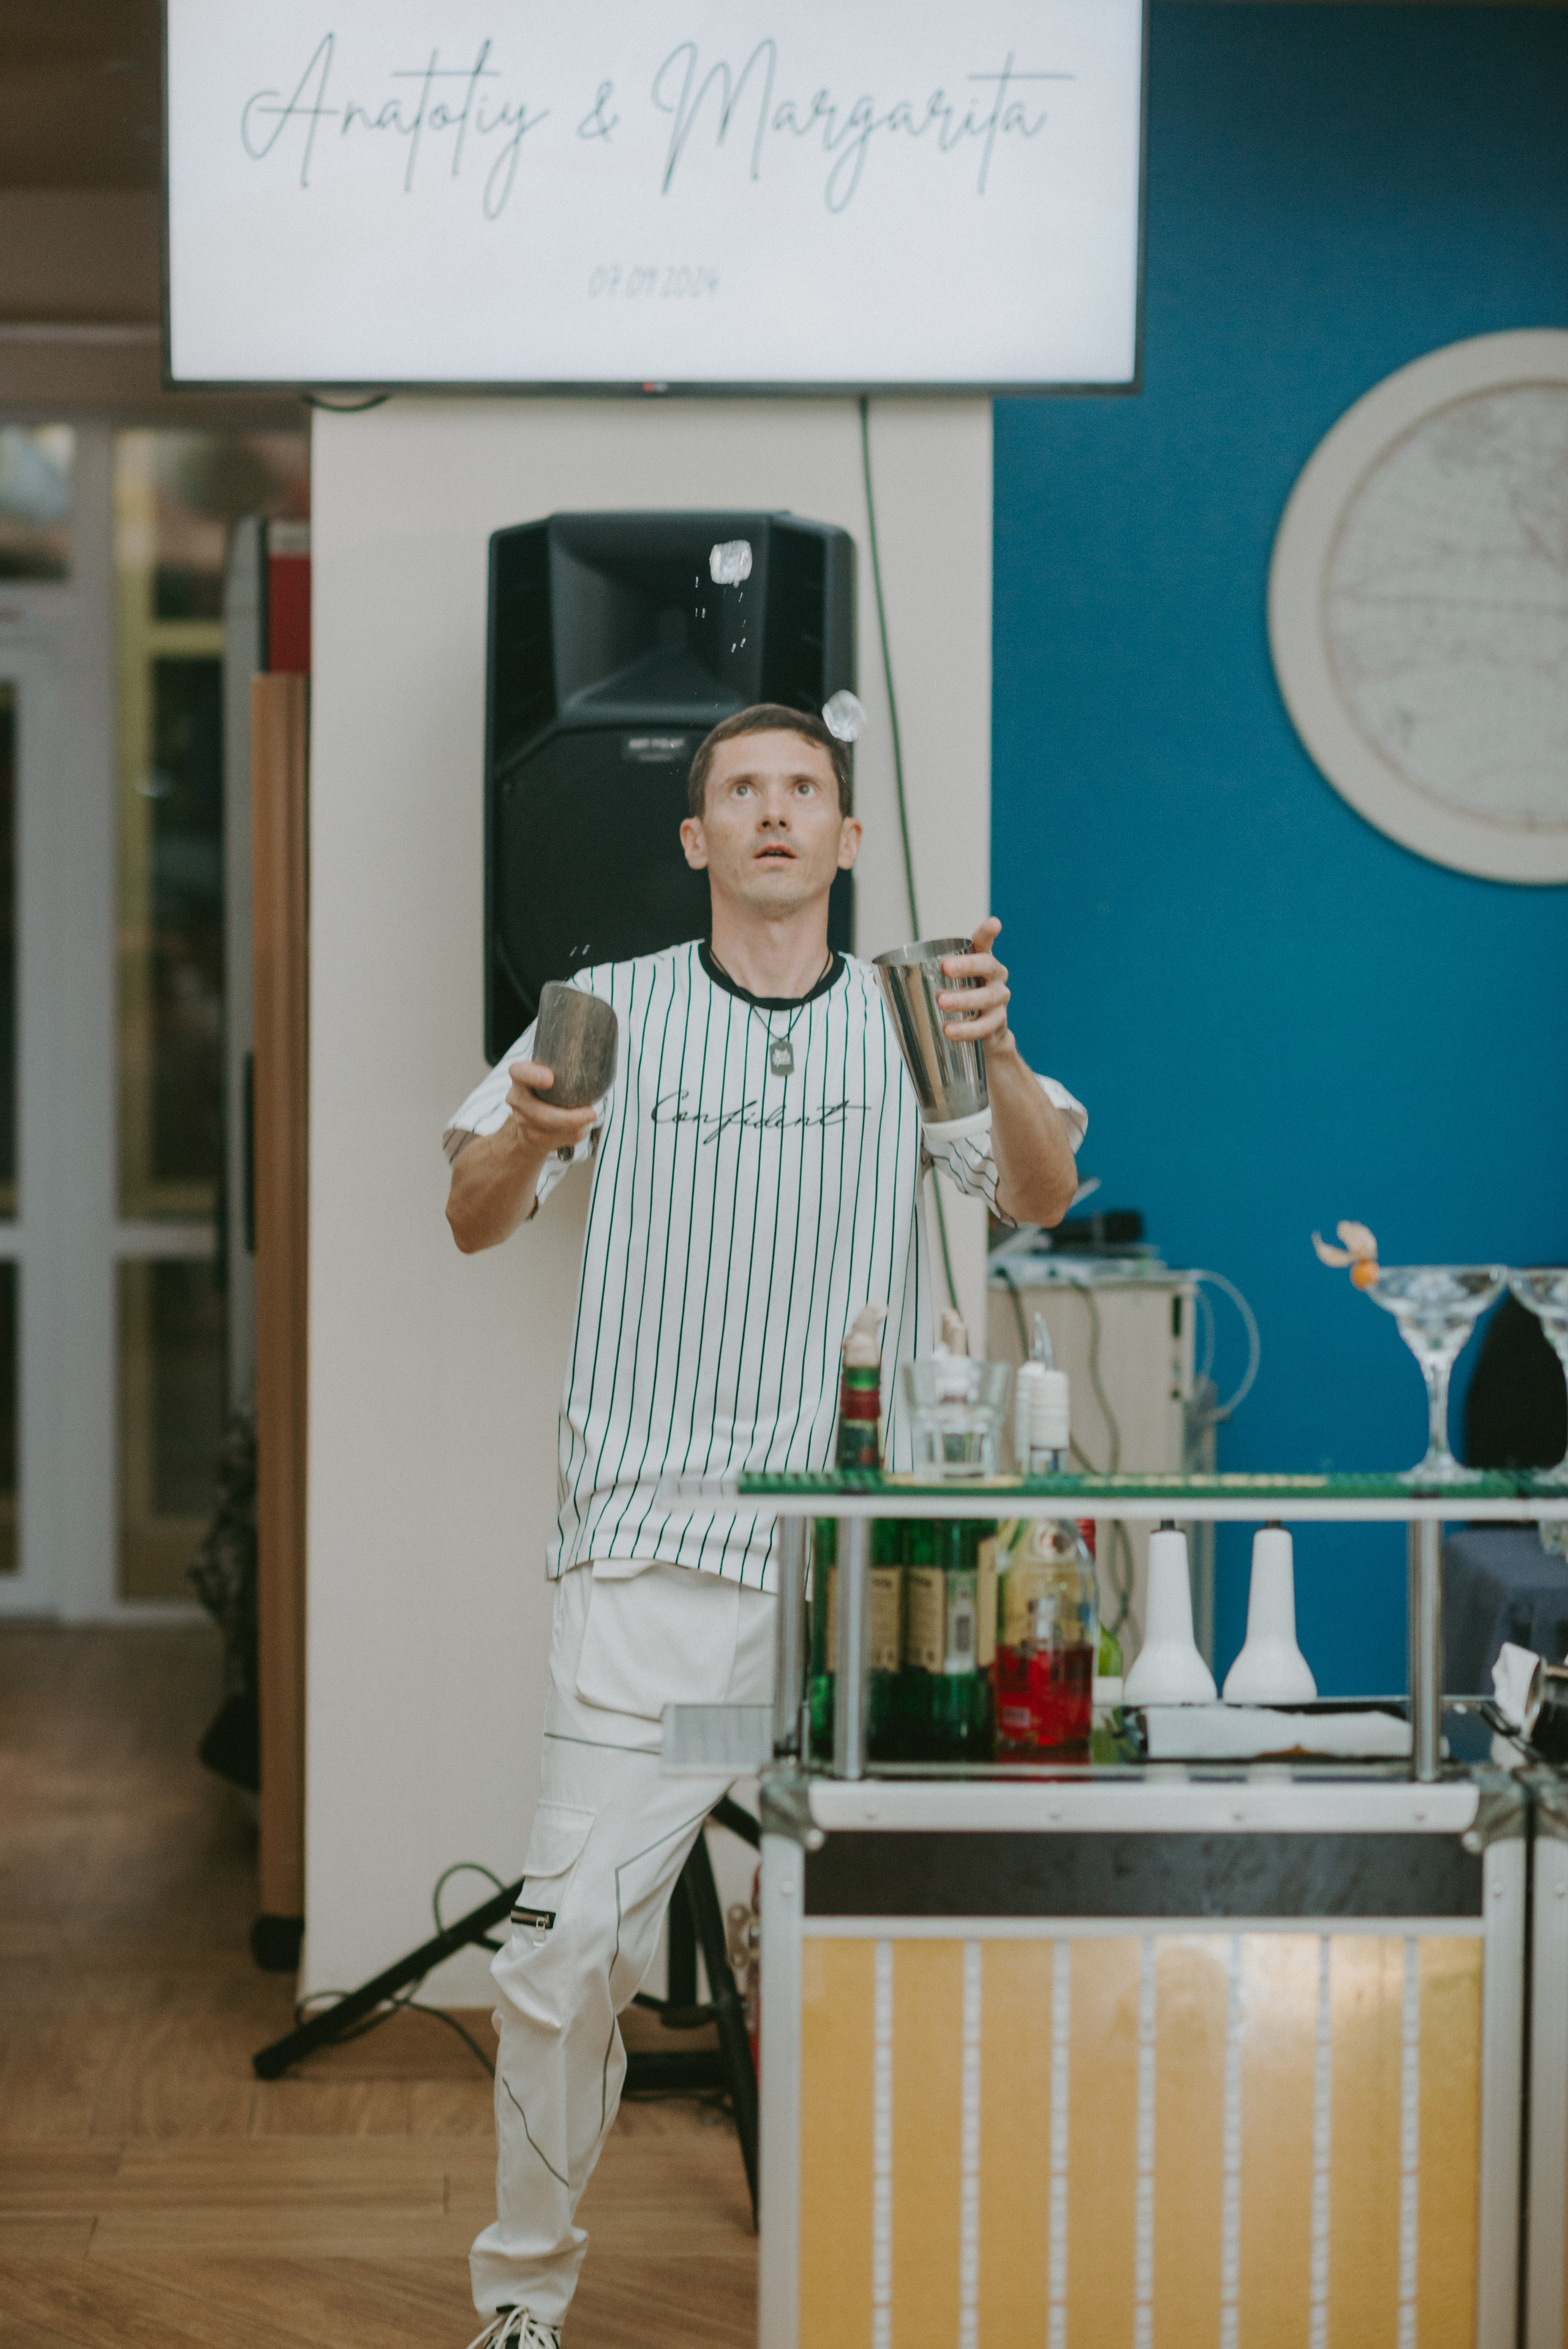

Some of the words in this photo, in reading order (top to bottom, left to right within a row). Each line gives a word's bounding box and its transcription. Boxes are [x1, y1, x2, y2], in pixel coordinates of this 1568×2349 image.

[576, 80, 621, 143] &
[650, 38, 1076, 214] Margarita
[650, 1089, 872, 1145] Confident
